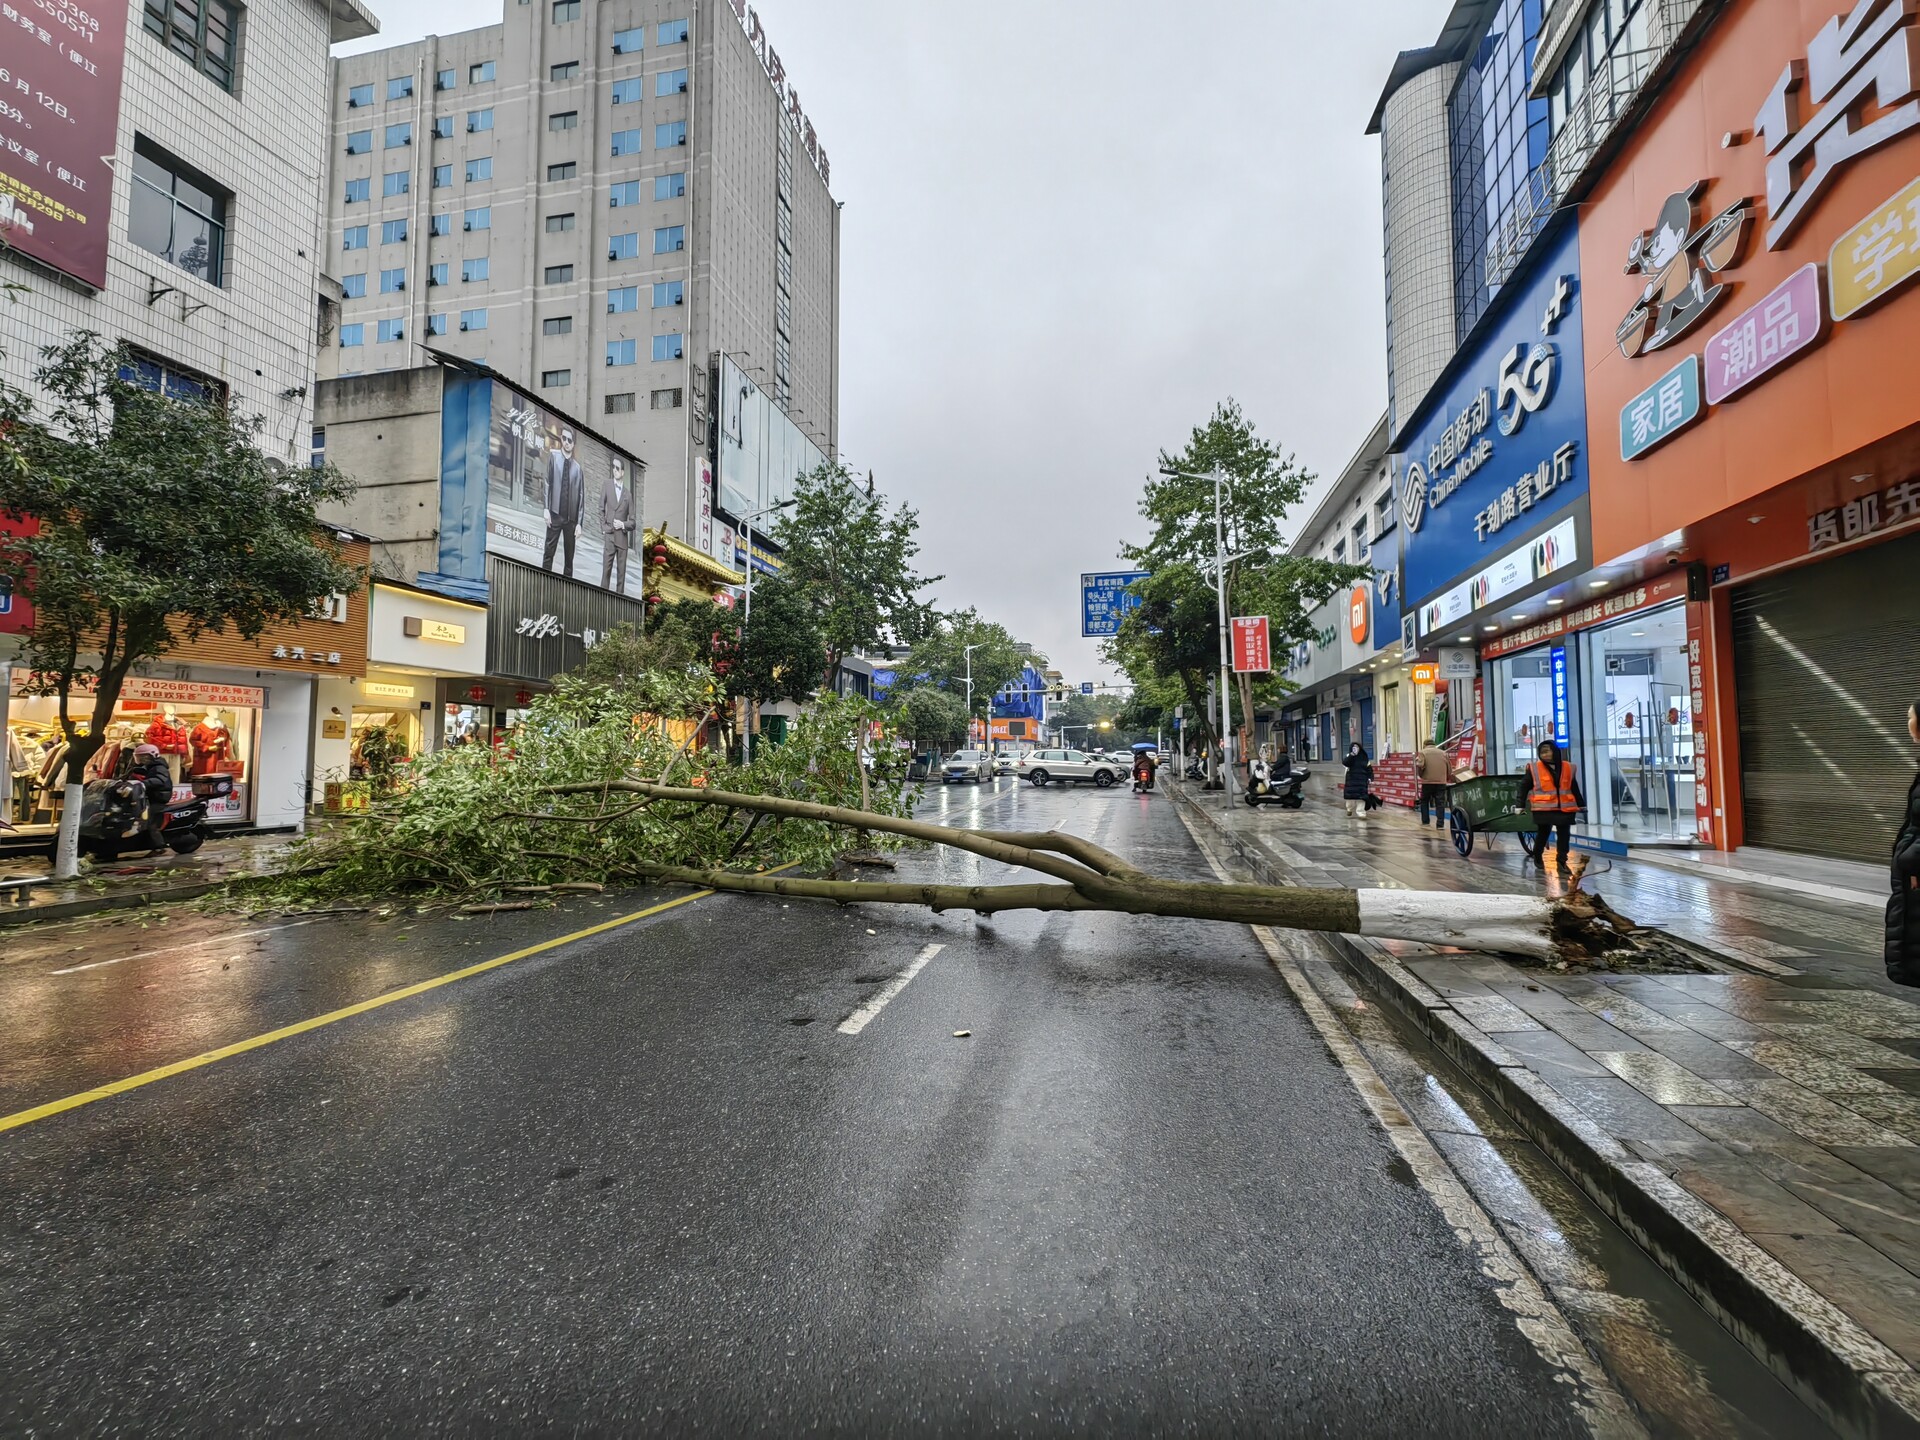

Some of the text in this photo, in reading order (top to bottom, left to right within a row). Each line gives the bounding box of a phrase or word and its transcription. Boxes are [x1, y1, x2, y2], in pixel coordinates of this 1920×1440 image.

[1720, 291, 1800, 387] 潮品
[1428, 386, 1491, 480] 中国移动
[1630, 373, 1684, 447] 家居
[1474, 440, 1576, 542] 干劲路营业厅
[1604, 587, 1647, 616] 优惠越多
[1555, 659, 1566, 736] 中国移动通信
